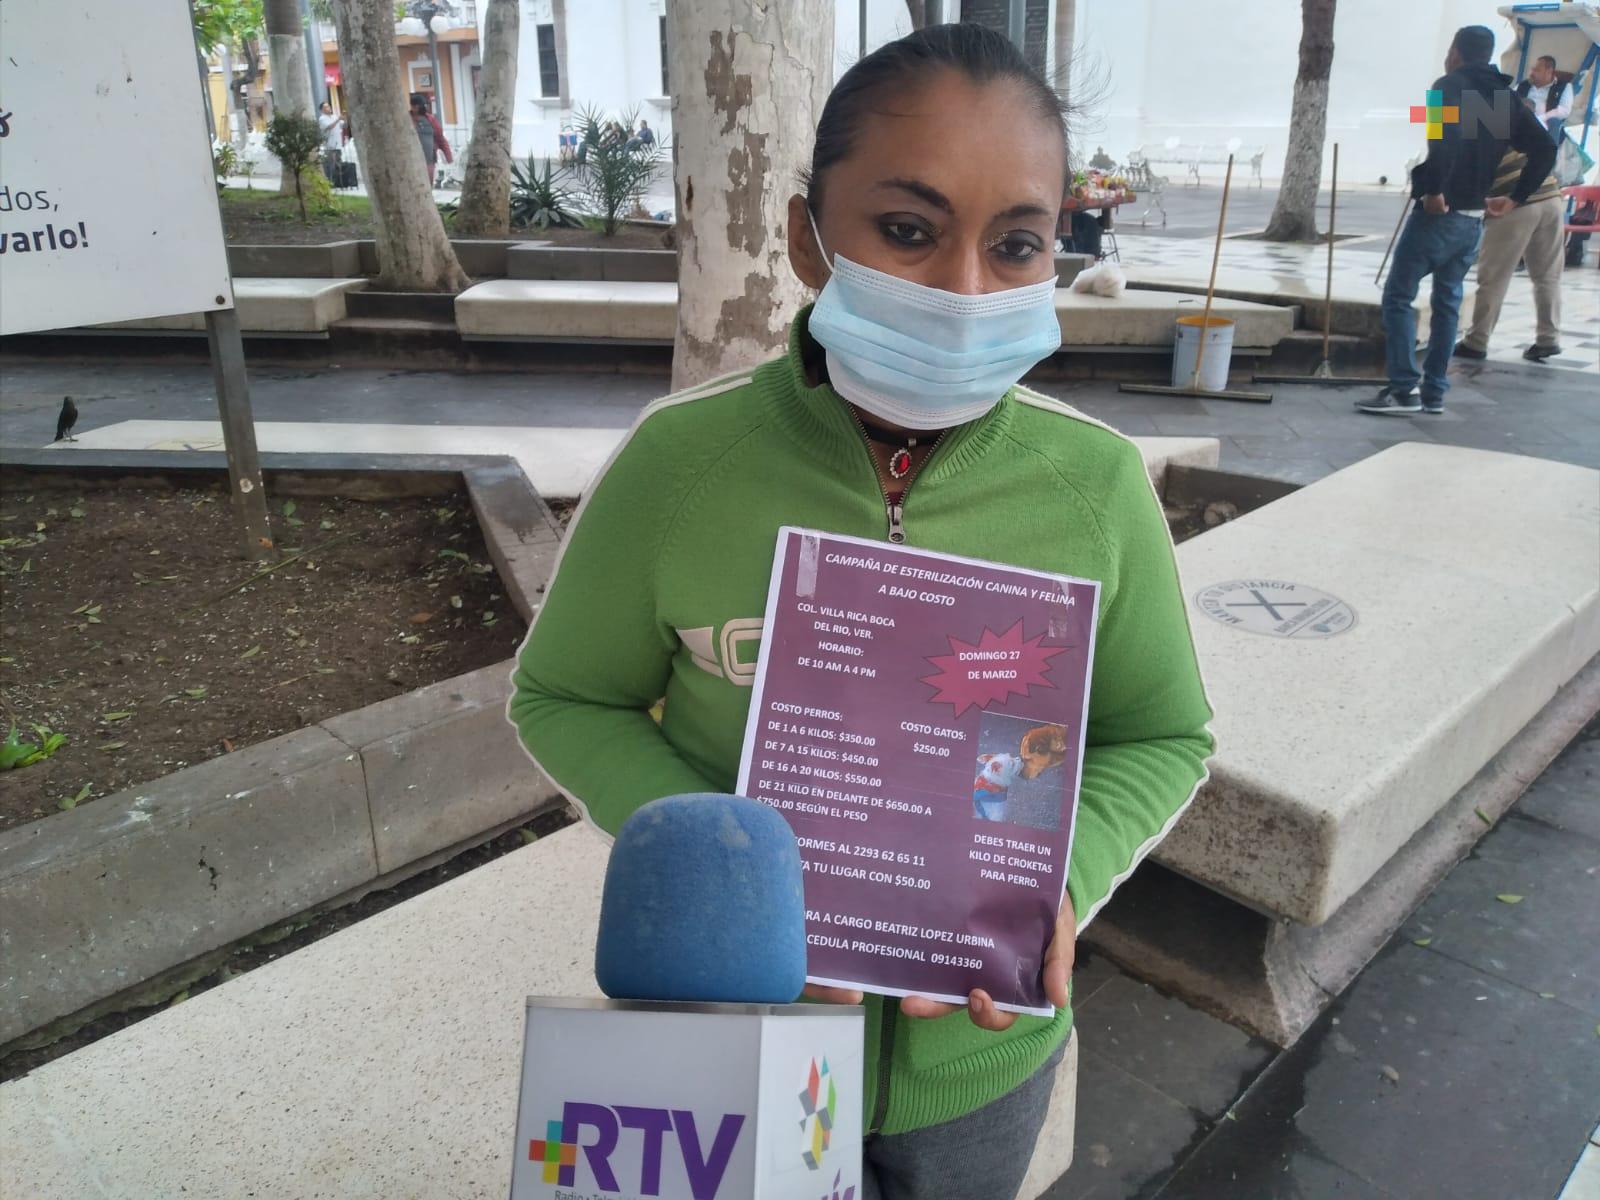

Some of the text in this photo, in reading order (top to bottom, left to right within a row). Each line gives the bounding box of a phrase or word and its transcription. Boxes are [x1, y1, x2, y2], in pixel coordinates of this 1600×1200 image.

[825, 553, 1075, 606] CAMPAÑA DE ESTERILIZACIÓN CANINA Y FELINA
[879, 584, 955, 606] A BAJO COSTO
[797, 602, 895, 628] COL. VILLA RICA BOCA
[814, 621, 874, 640] DEL RIO, VER.
[818, 641, 864, 657] HORARIO:
[959, 651, 1021, 661] DOMINGO 27
[798, 656, 876, 678] DE 10 AM A 4 PM
[968, 670, 1017, 679] DE MARZO
[771, 702, 843, 721] COSTO PERROS:
[768, 721, 876, 747] DE 1 A 6 KILOS: $350.00
[900, 721, 967, 741] COSTO GATOS:
[765, 740, 879, 767] DE 7 A 15 KILOS: $450.00
[913, 742, 950, 757] $250.00
[762, 760, 881, 787] DE 16 A 20 KILOS: $550.00
[759, 780, 932, 816] DE 21 KILO EN DELANTE DE $650.00 A
[795, 802, 829, 815] SEGÚN
[831, 808, 841, 817] EL
[843, 810, 868, 822] PESO
[794, 836, 925, 866] ORMES AL 2293 62 65 11
[974, 834, 1051, 856] DEBES TRAER UN
[969, 850, 1053, 873] KILO DE CROKETAS
[813, 862, 828, 873] TU
[830, 865, 866, 879] LUGAR
[869, 871, 893, 883] CON
[895, 874, 931, 889] $50.00
[980, 869, 1039, 888] PARA PERRO.
[823, 913, 831, 923] A
[834, 915, 872, 929] CARGO
[875, 921, 918, 937] BEATRIZ
[920, 928, 953, 942] LOPEZ
[956, 933, 995, 949] URBINA
[806, 934, 982, 970] CEDULA PROFESIONAL 09143360
[557, 1100, 746, 1200] RTV
